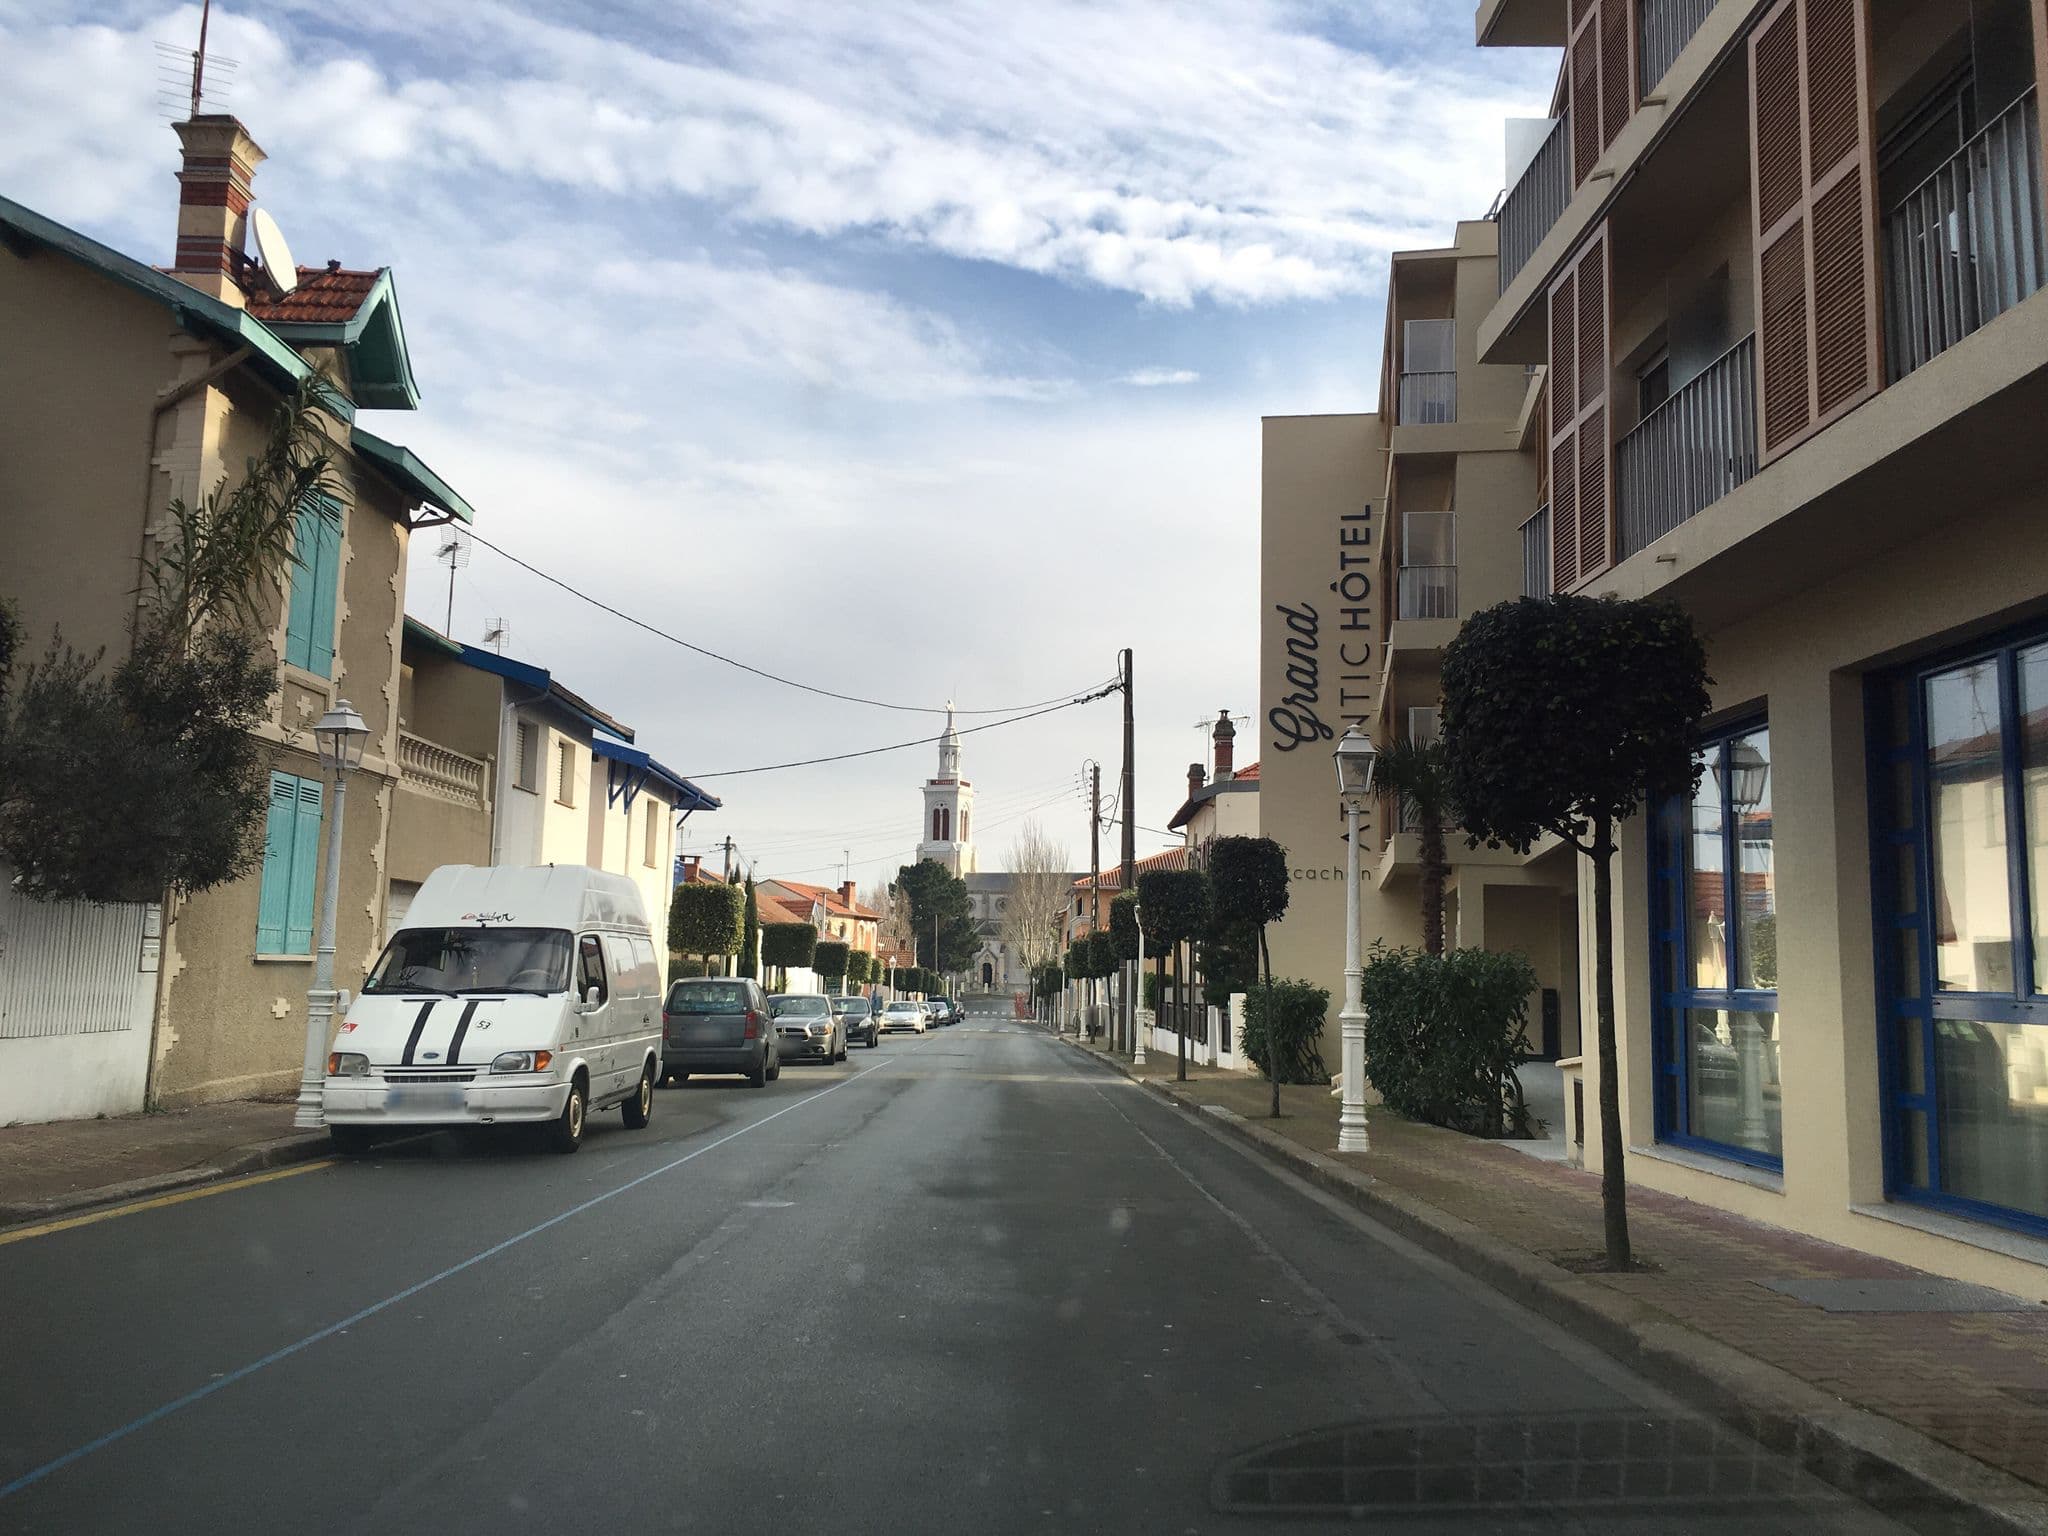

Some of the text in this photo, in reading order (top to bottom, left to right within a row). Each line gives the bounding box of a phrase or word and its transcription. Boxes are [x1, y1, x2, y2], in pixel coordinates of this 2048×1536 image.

[1268, 601, 1334, 752] Grand
[1330, 504, 1371, 851] ATNTIC HÔTEL
[1293, 866, 1371, 881] cachn
